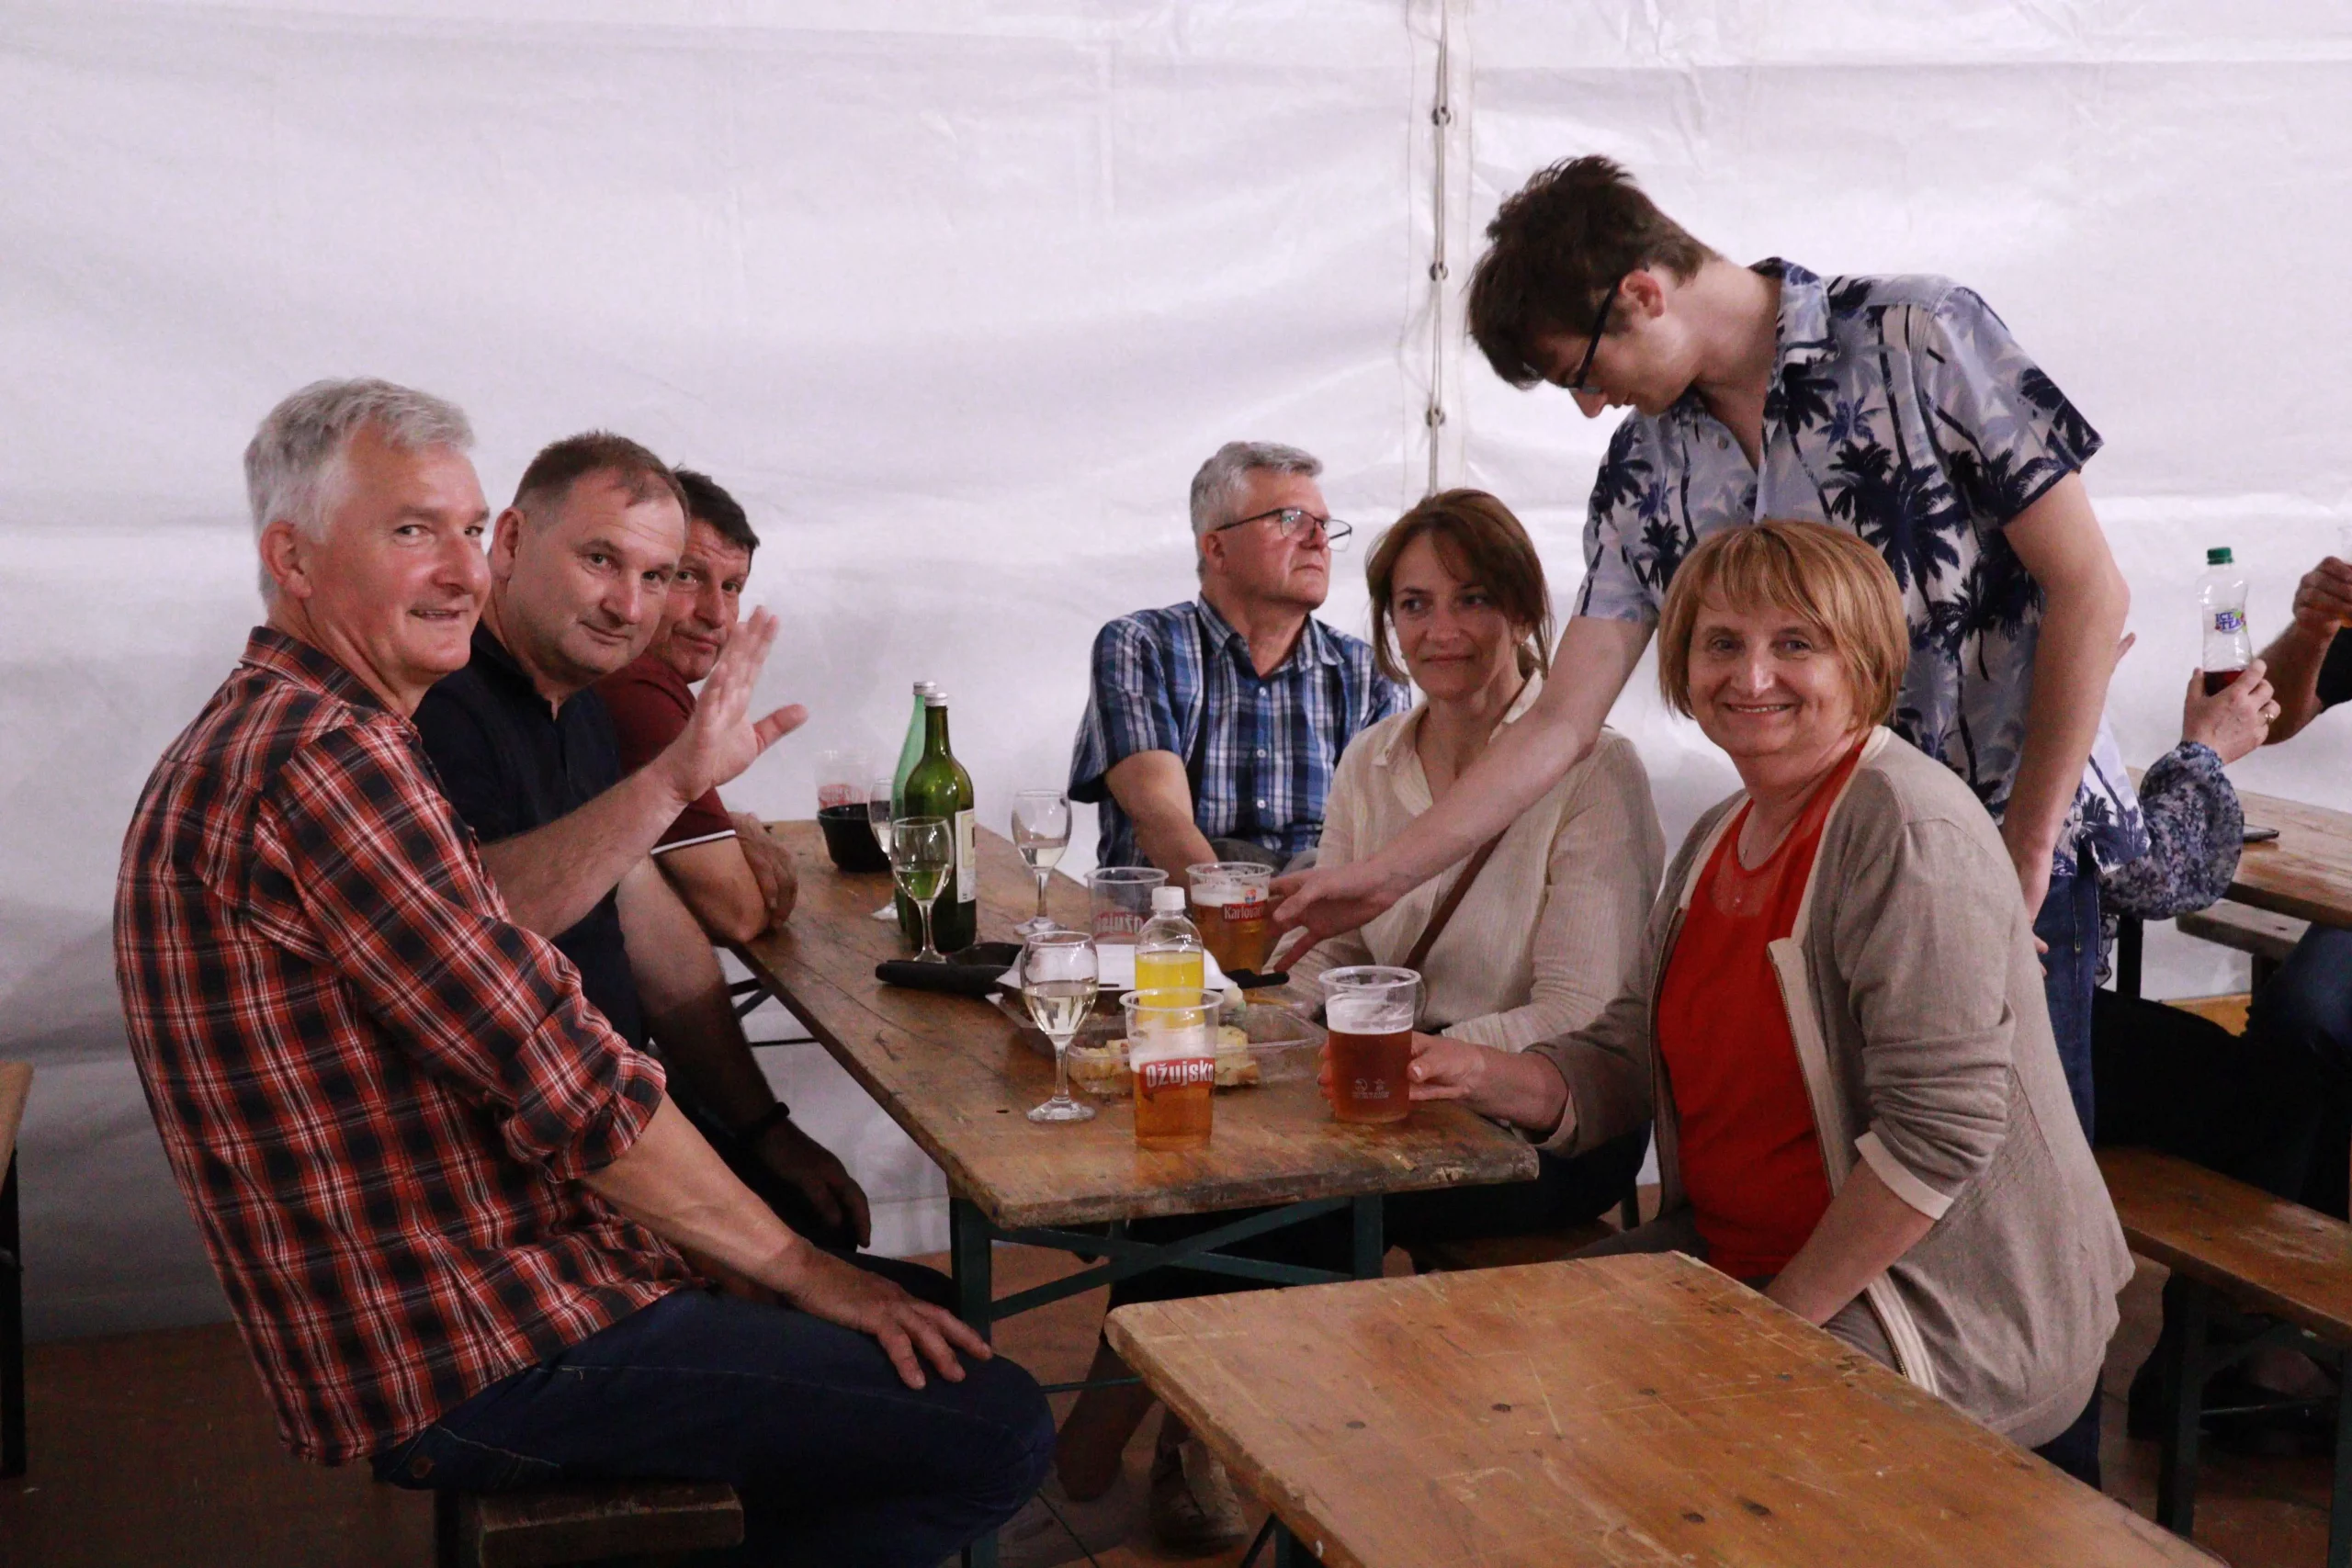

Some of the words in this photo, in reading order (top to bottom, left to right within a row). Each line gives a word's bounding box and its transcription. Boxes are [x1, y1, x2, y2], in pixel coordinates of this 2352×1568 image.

[2215, 612, 2234, 624] ICE
[2220, 618, 2242, 630] TEA
[1145, 1059, 1214, 1089] Ožujsko
